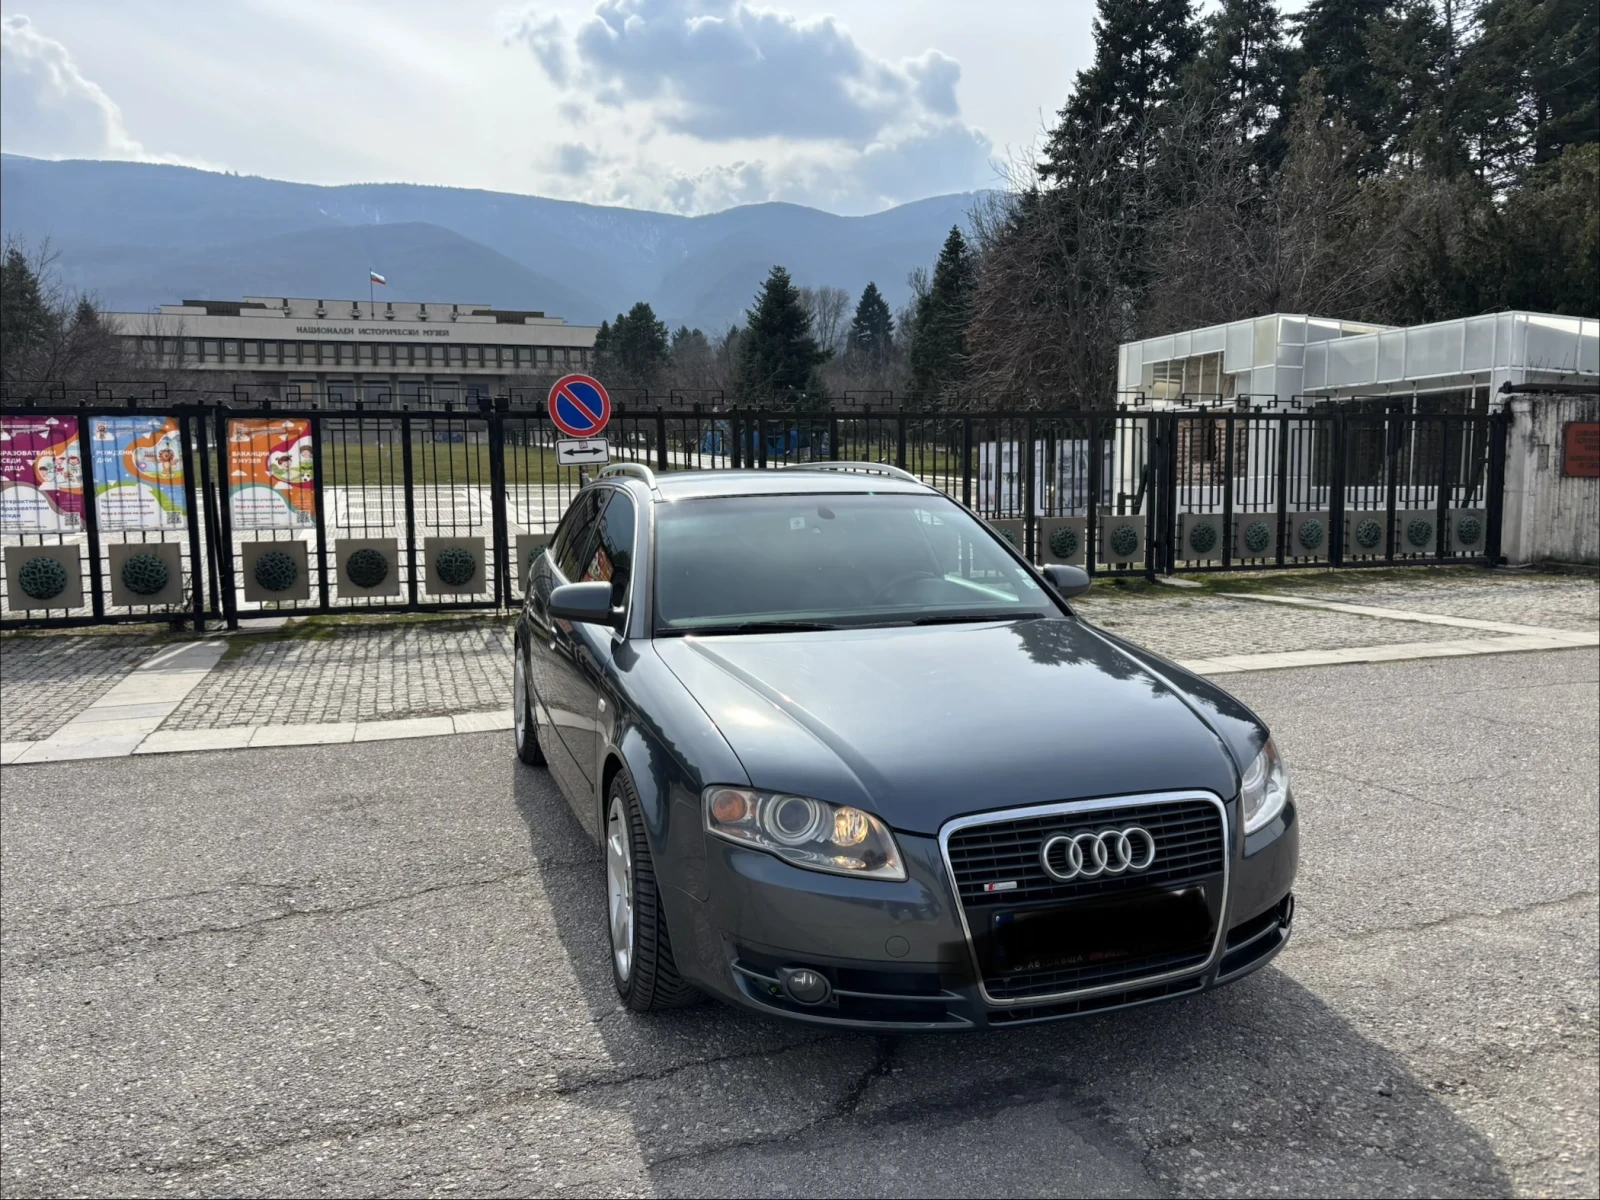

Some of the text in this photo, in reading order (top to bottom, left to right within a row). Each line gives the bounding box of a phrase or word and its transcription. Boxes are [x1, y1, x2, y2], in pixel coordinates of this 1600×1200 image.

[296, 326, 450, 337] НАЦИОНАЛЕН ИСТОРИЧЕСКИ МУЗЕЙ
[1027, 954, 1084, 969] АВТОКЪЩА
